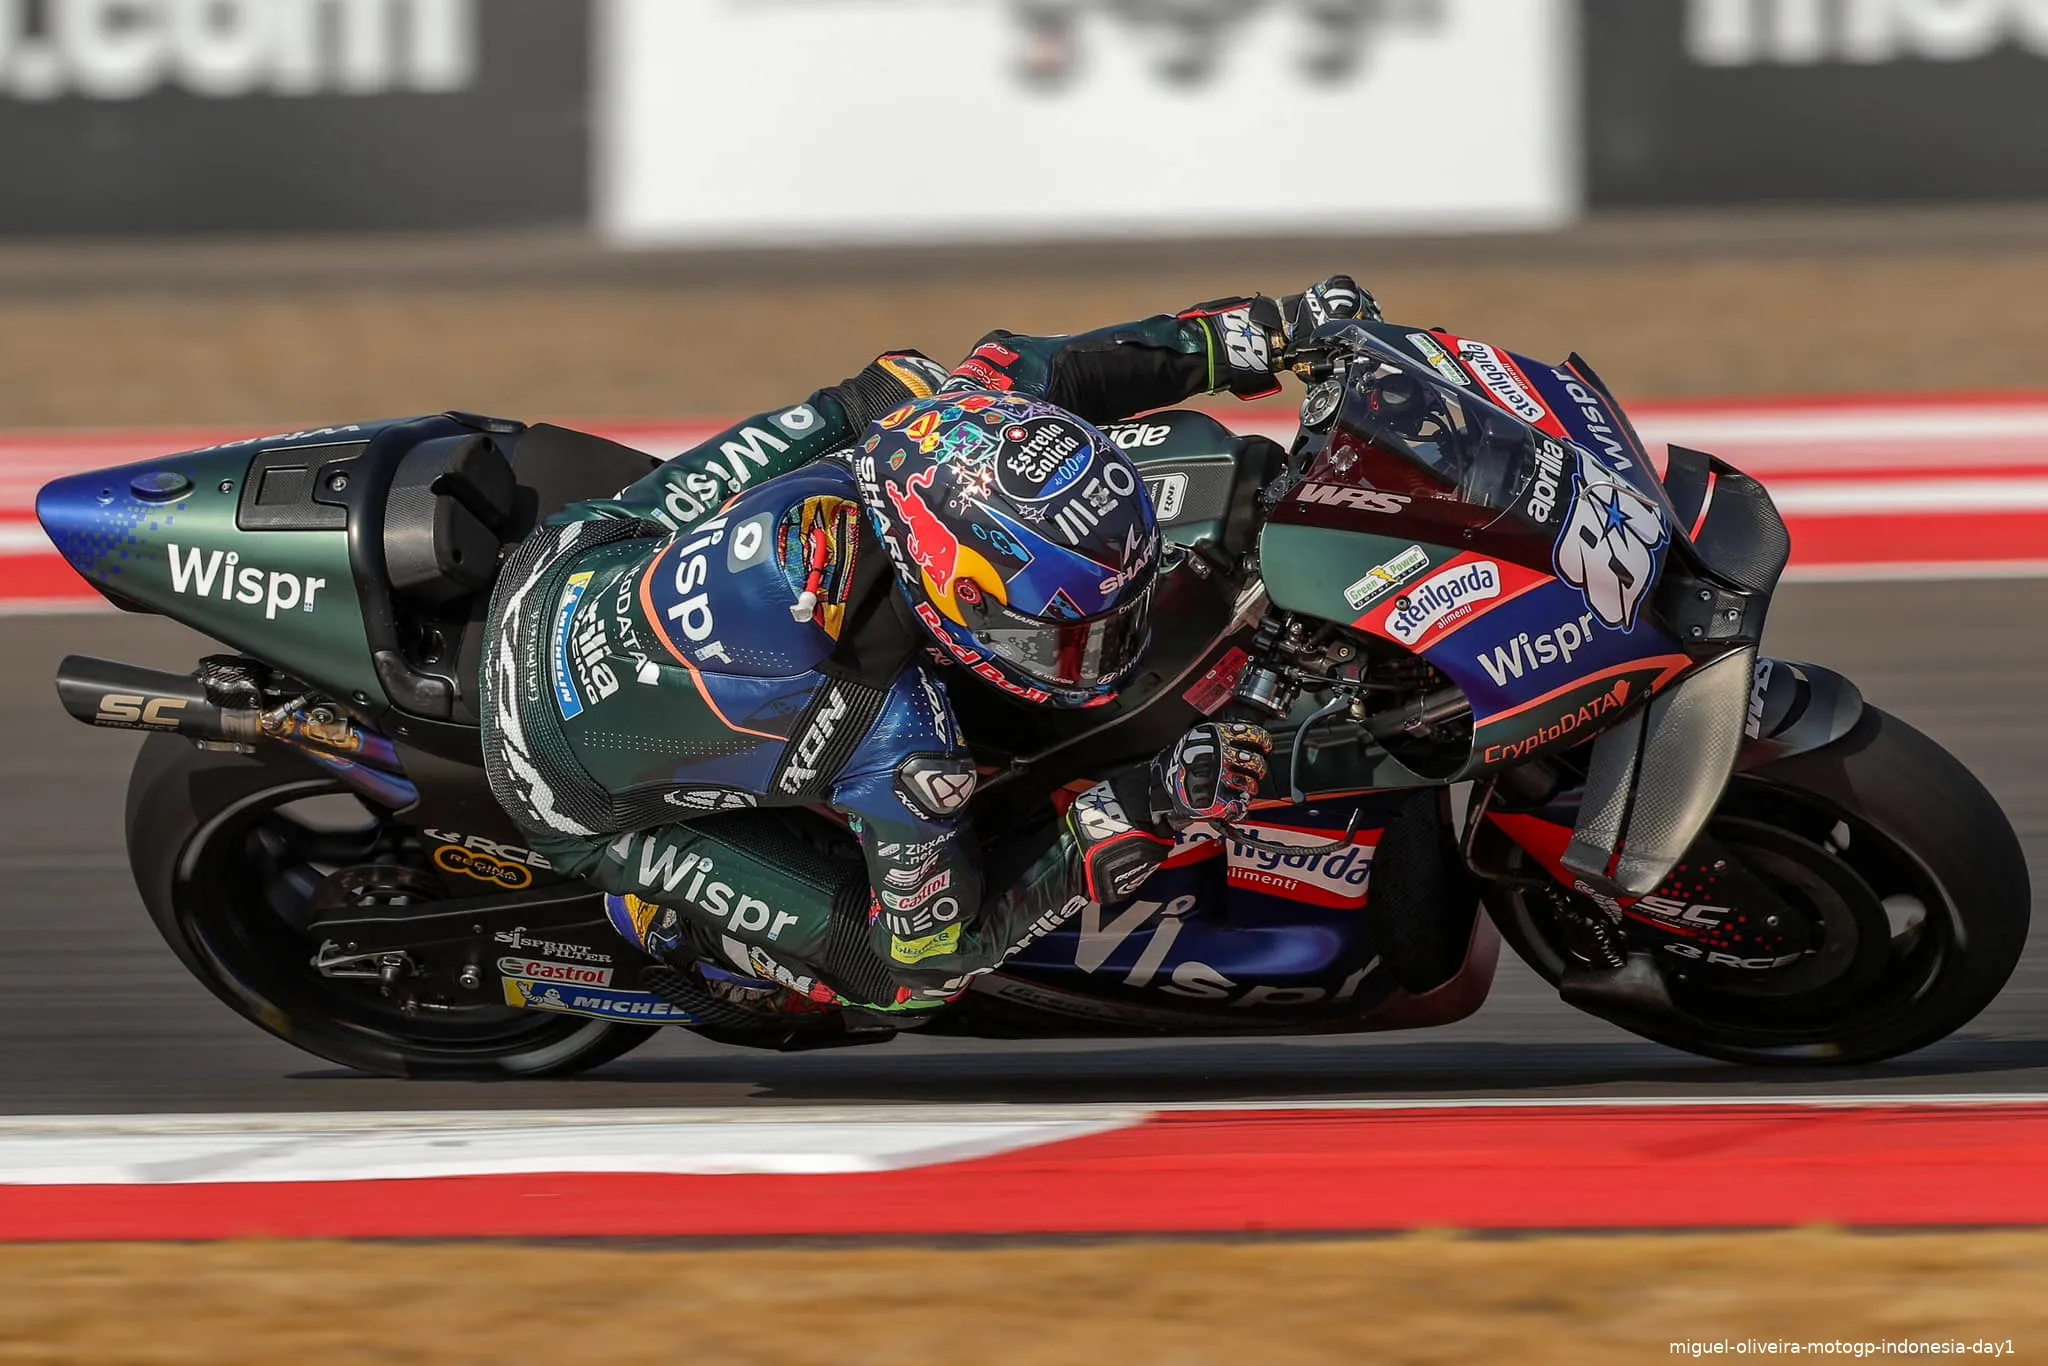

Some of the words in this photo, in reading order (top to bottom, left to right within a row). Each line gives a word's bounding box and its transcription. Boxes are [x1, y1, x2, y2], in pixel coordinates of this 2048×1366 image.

[1007, 424, 1064, 476] Estrella
[1551, 369, 1632, 470] Wispr
[1025, 437, 1079, 483] Galicia
[1527, 439, 1564, 523] aprilia
[860, 455, 919, 585] SHARK
[1296, 483, 1411, 514] WRS
[167, 543, 326, 620] Wispr
[1394, 565, 1494, 637] sterilgarda
[1436, 604, 1472, 629] alimenti
[555, 610, 573, 703] MICHELIN
[914, 600, 982, 665] Red
[970, 661, 1052, 704] Bull
[1477, 614, 1592, 687] Wispr
[95, 694, 188, 726] SC
[1485, 692, 1619, 764] CryptoDATA
[639, 835, 799, 941] Wispr
[898, 875, 947, 910] Castrol
[1633, 895, 1731, 925] SC
[520, 938, 592, 954] SPRINT
[525, 962, 606, 985] Castrol
[543, 950, 613, 963] FILTER
